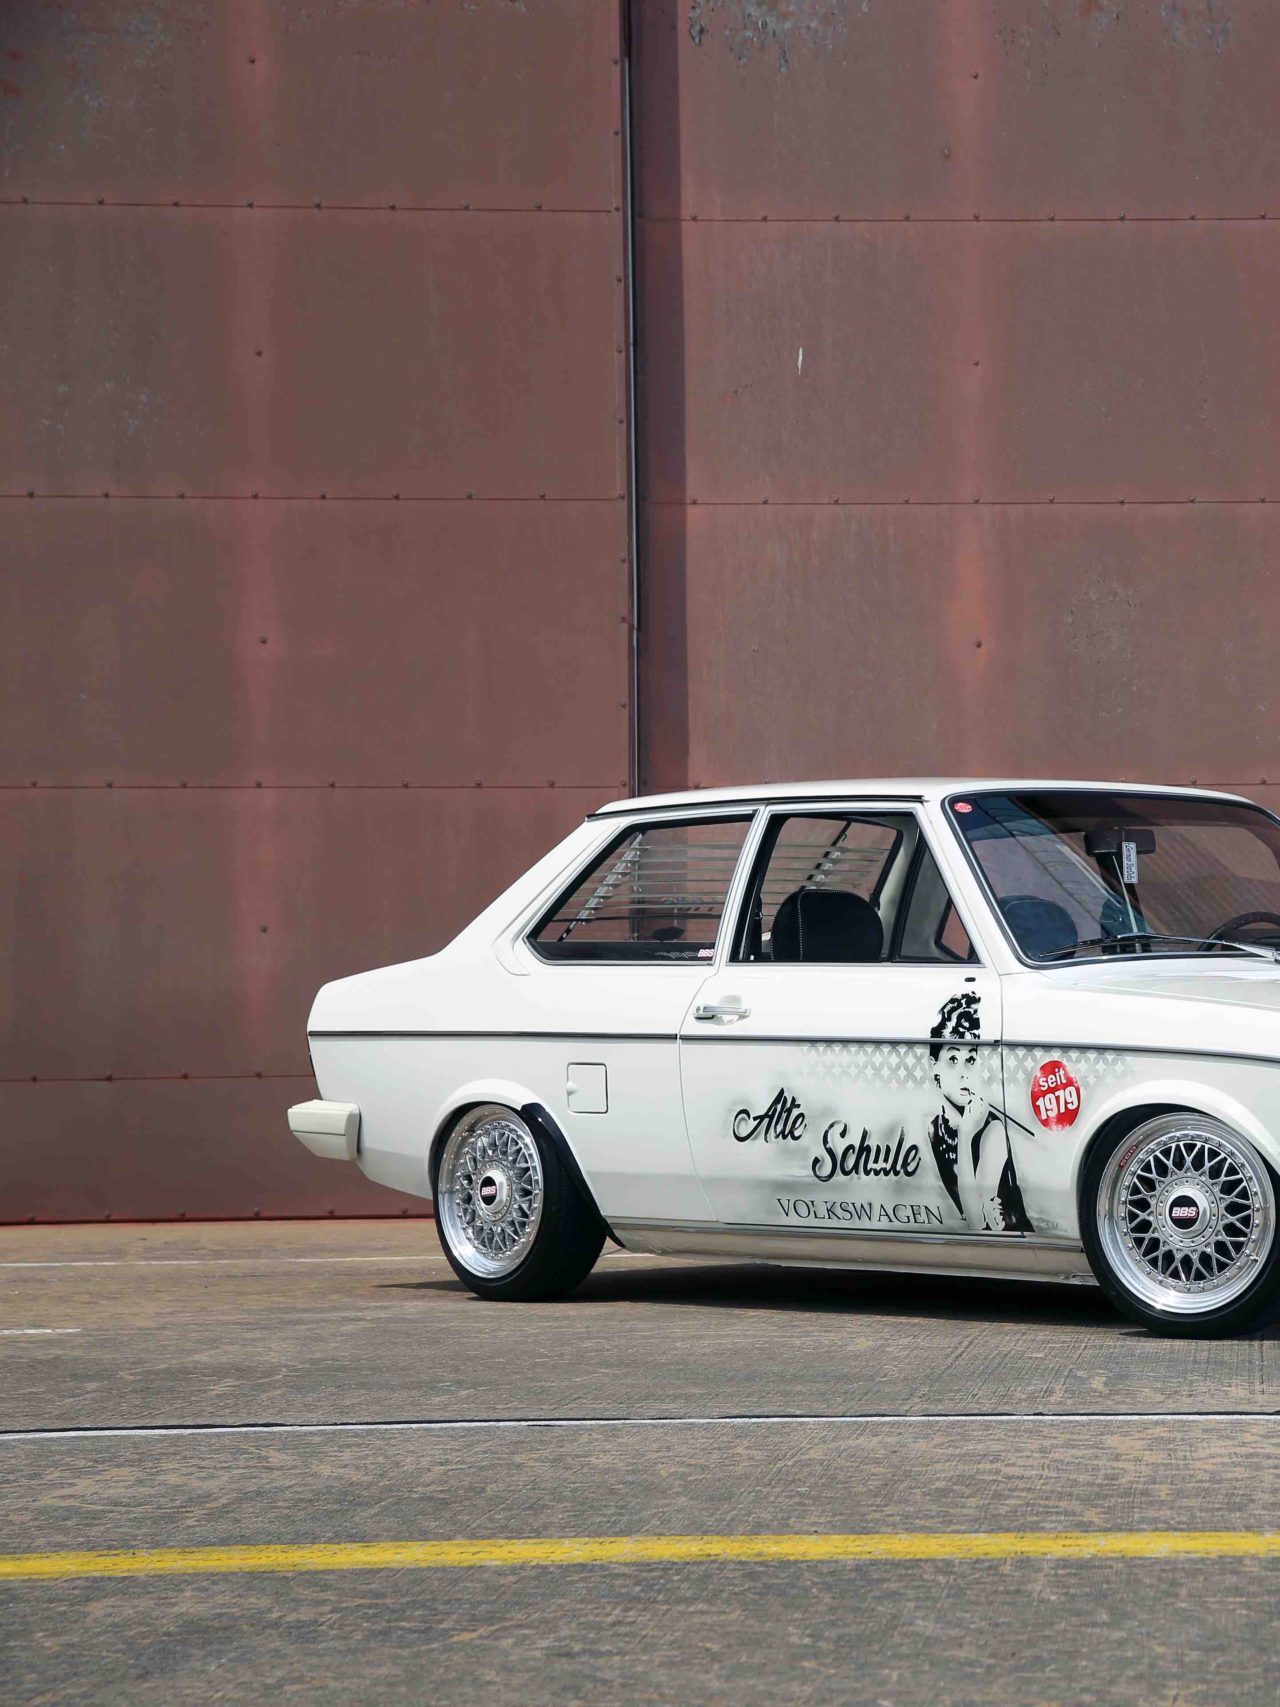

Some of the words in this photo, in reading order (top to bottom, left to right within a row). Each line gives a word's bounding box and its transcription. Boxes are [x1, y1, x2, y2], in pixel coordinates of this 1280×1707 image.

[698, 949, 714, 957] BBS
[1039, 1067, 1067, 1091] seit
[733, 1087, 807, 1143] Alte
[1036, 1086, 1079, 1120] 1979
[812, 1119, 922, 1182] Schule
[481, 1185, 496, 1196] BBS
[776, 1198, 944, 1225] VOLKSWAGEN
[1171, 1206, 1198, 1218] BBS
